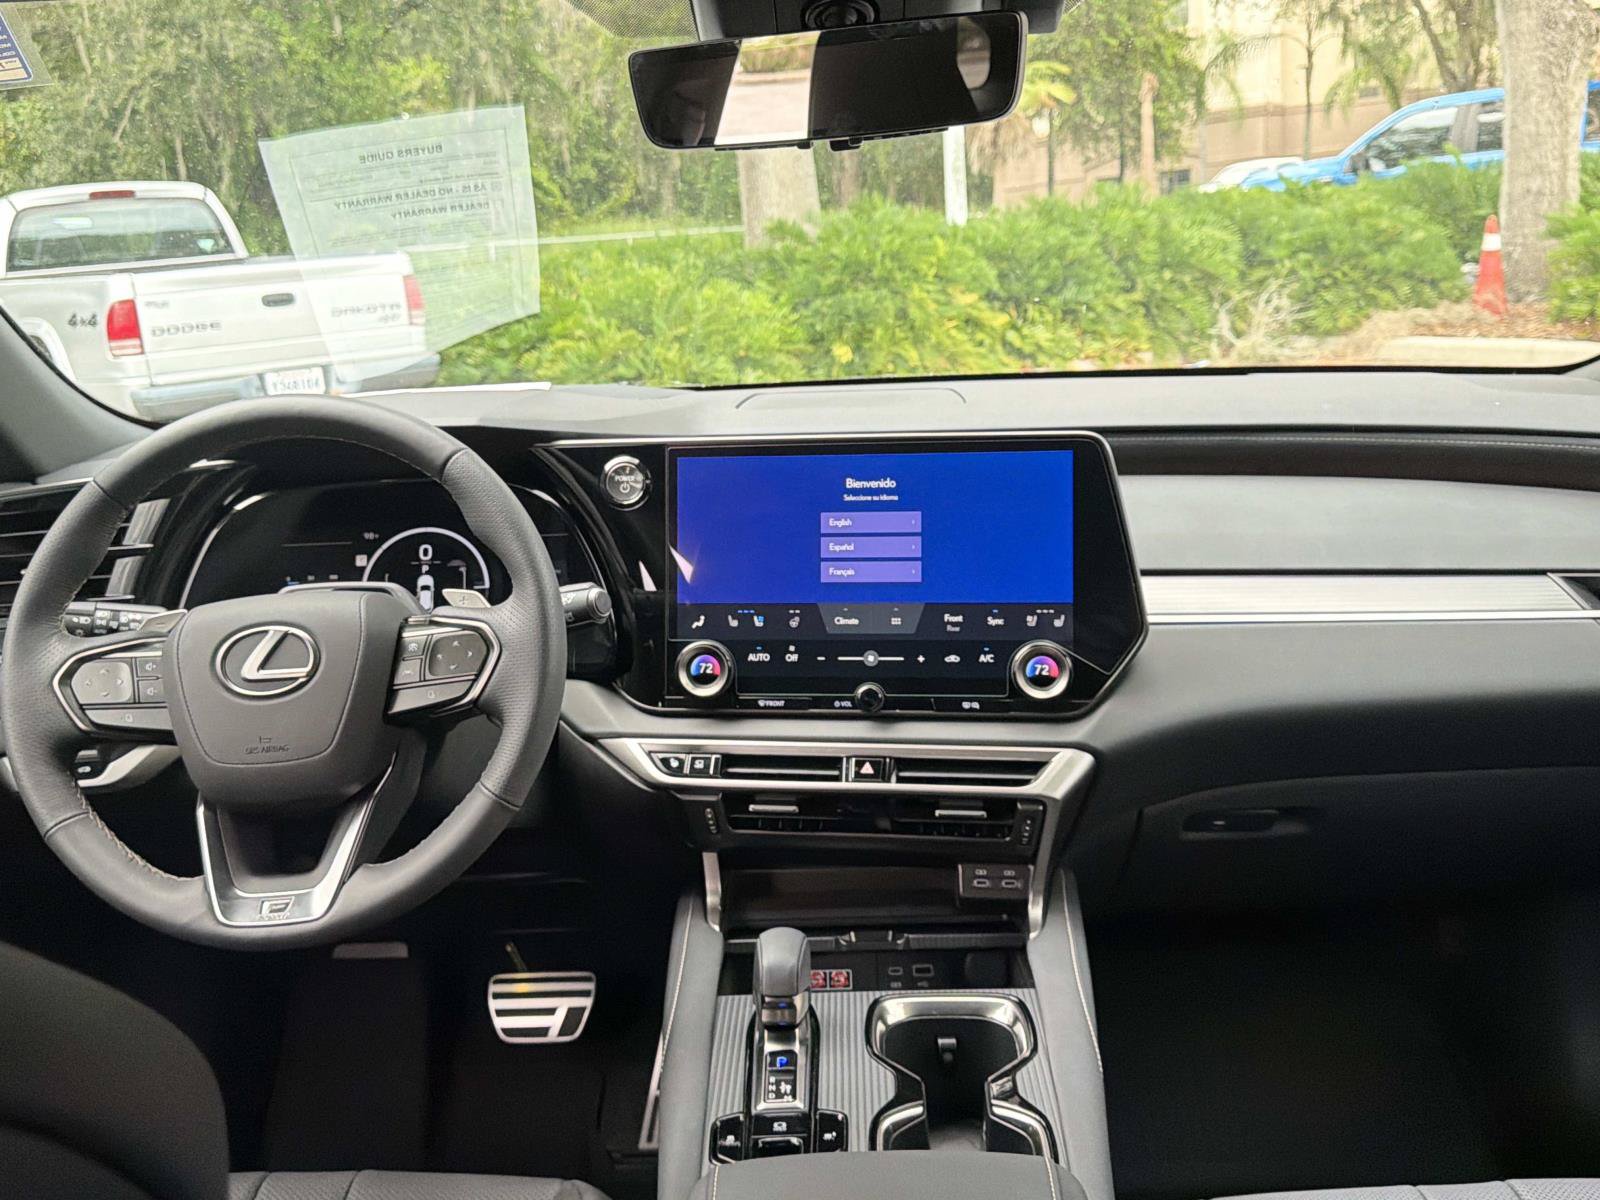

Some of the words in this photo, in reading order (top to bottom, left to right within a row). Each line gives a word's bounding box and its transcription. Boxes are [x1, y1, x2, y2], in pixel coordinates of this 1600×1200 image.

[845, 477, 897, 489] Bienvenido
[829, 518, 853, 528] English
[829, 543, 855, 553] Español
[829, 567, 856, 577] Français
[833, 616, 860, 626] Climate
[944, 613, 964, 623] Front
[987, 616, 1005, 627] Sync
[747, 653, 771, 662] AUTO
[785, 653, 799, 662] Off
[978, 653, 995, 664] A/C
[699, 662, 714, 674] 72
[1034, 663, 1050, 676] 72
[840, 700, 853, 708] VOL
[776, 1056, 788, 1069] P
